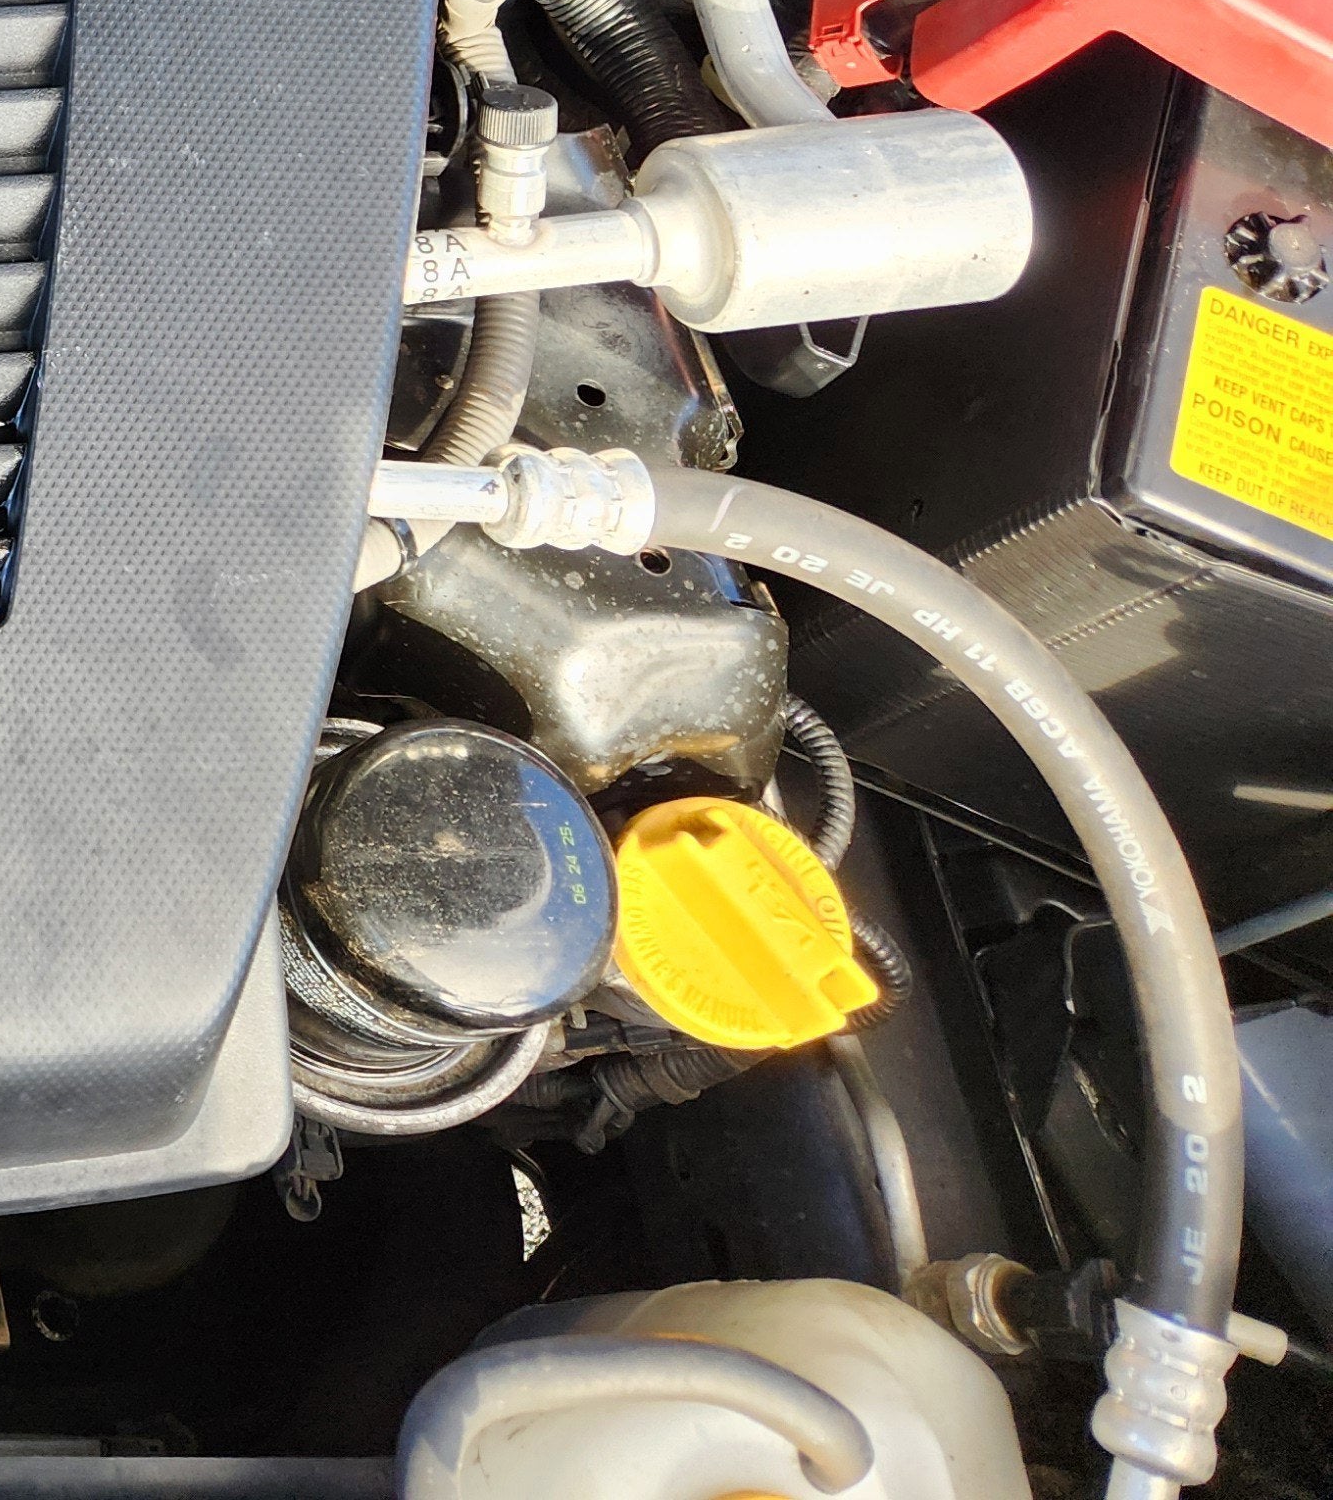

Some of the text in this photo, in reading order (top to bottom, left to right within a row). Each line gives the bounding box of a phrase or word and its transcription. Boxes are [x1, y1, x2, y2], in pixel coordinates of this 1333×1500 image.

[1209, 297, 1301, 349] DANGER
[1192, 392, 1282, 444] POISON
[1214, 375, 1248, 398] KEEP
[1251, 390, 1286, 416] VENT
[1289, 406, 1325, 434] CAPS
[1199, 461, 1233, 484] KEEP
[1236, 477, 1264, 500] OUT
[1267, 491, 1287, 508] OF
[723, 532, 1161, 899] YOKOHAMA AC6B 11 HP JE 20 2
[564, 854, 581, 876] 24
[571, 882, 587, 905] 06
[1179, 1073, 1210, 1287] JE 20 2
